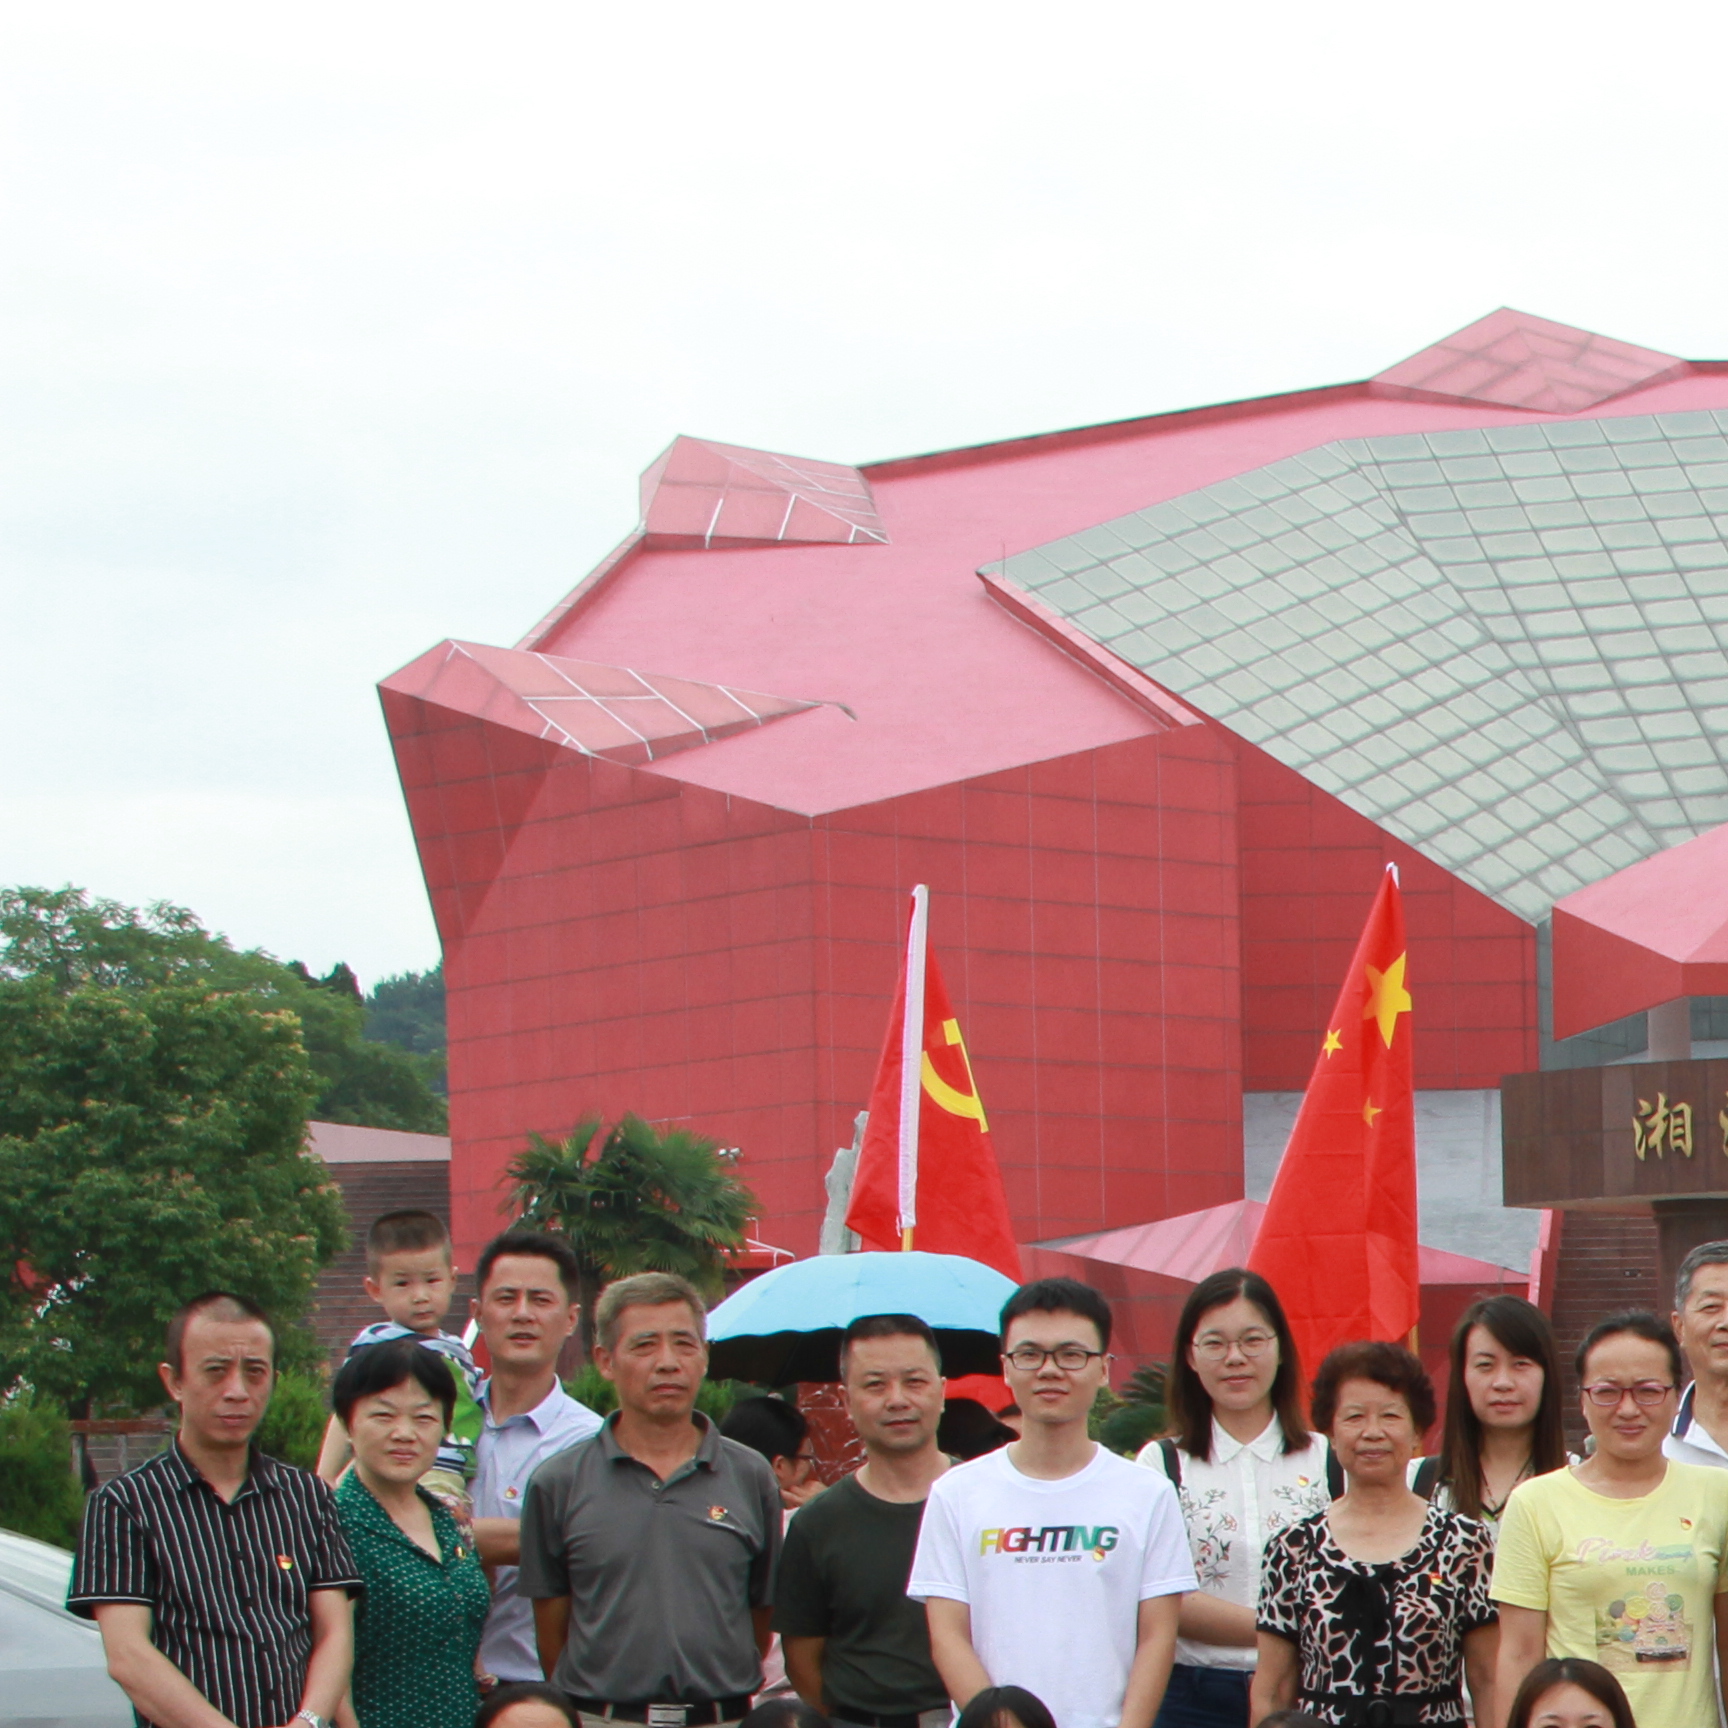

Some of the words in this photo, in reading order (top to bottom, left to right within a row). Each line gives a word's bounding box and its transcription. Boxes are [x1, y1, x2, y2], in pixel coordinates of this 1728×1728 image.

[980, 1525, 1119, 1556] FIGHTING
[1014, 1556, 1040, 1564] NEVER
[1057, 1555, 1082, 1563] NEVER
[1626, 1565, 1675, 1576] MAKES
